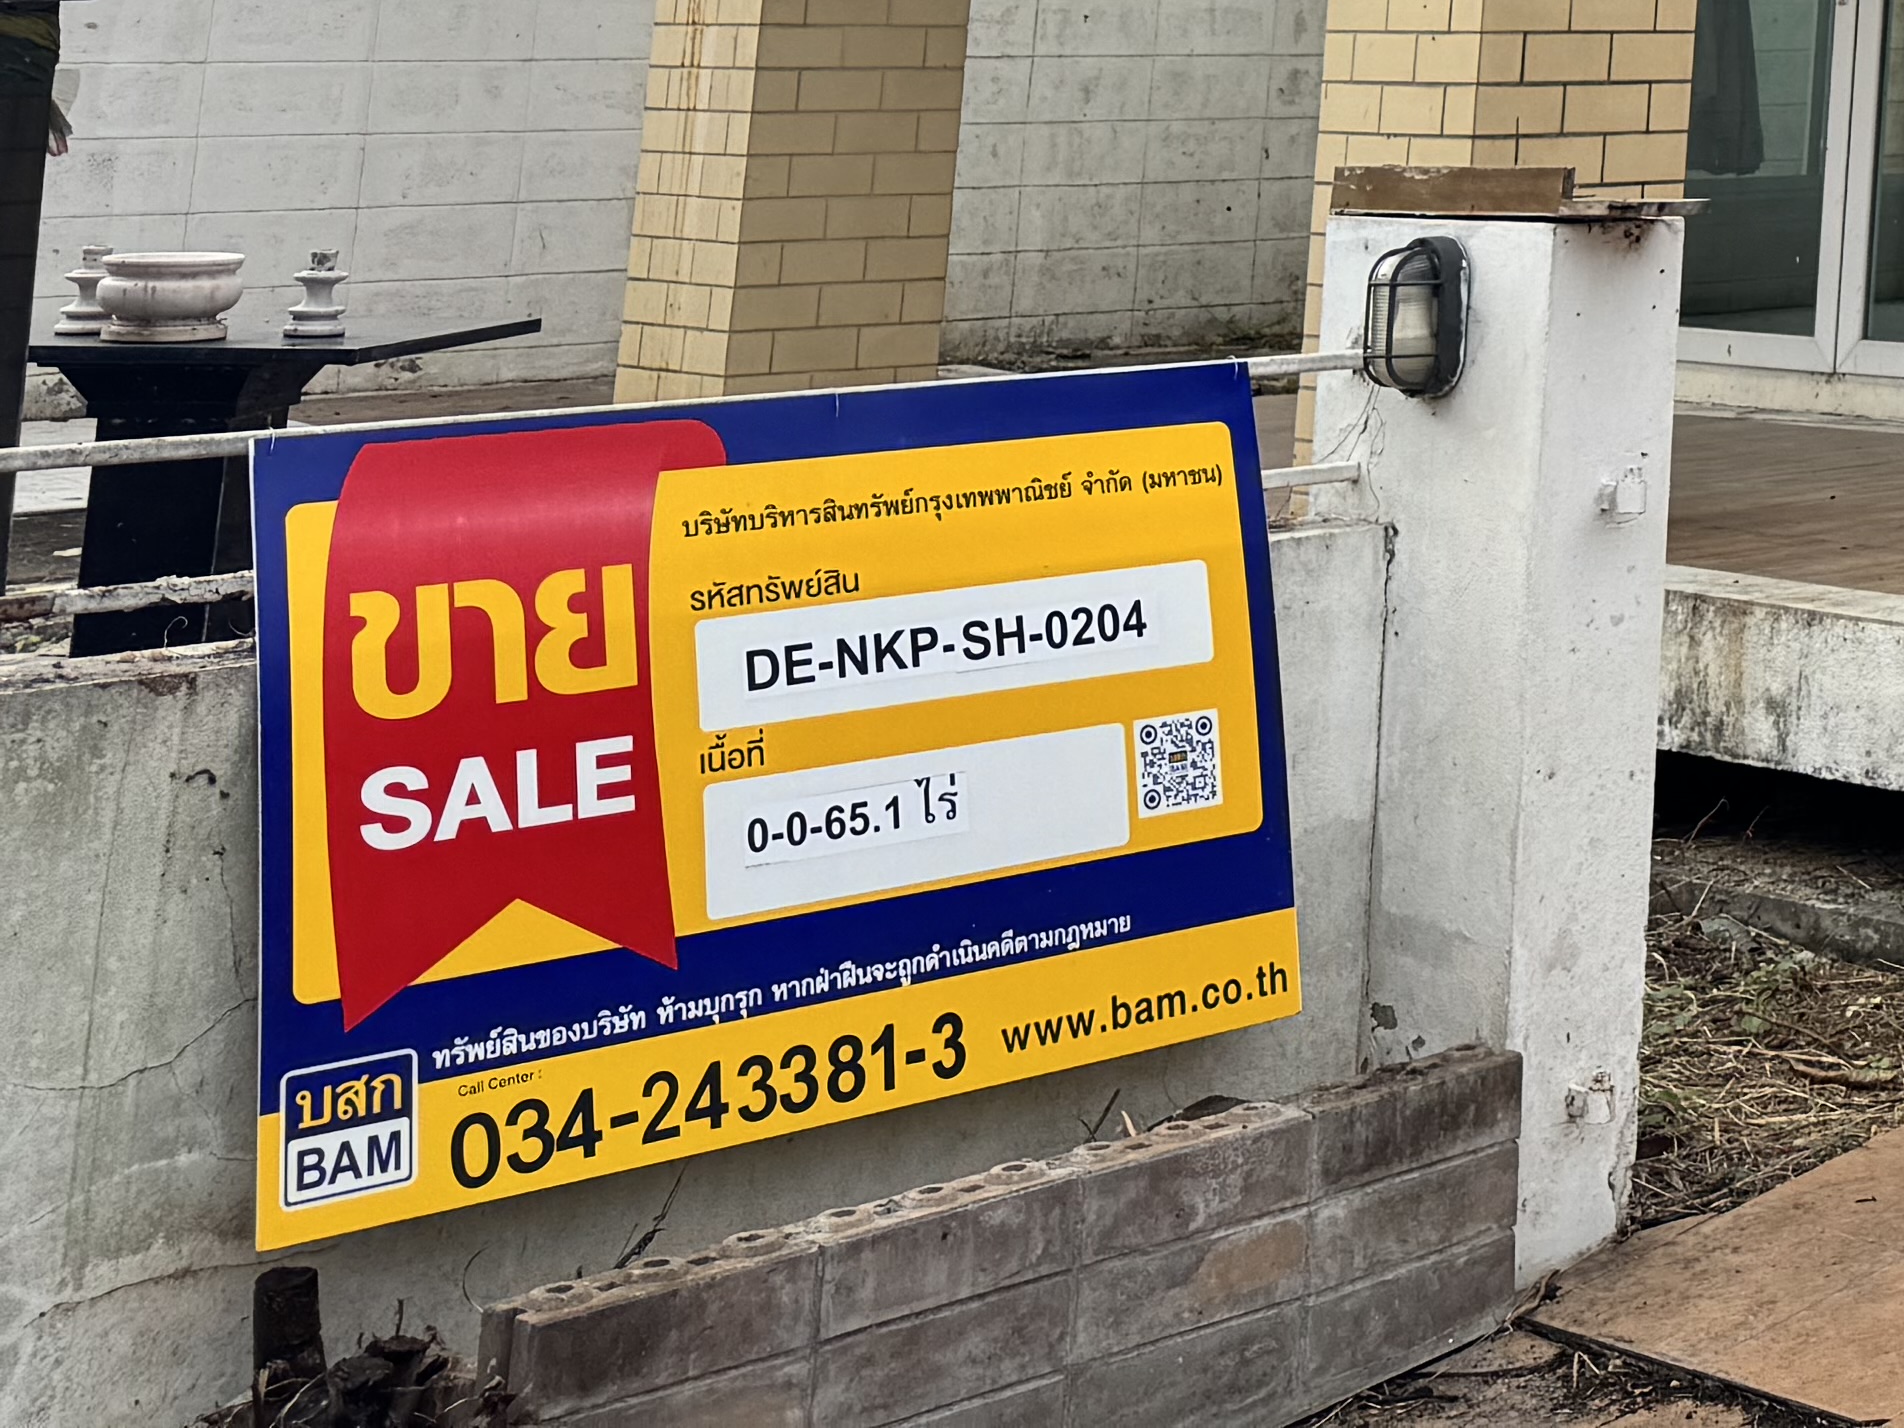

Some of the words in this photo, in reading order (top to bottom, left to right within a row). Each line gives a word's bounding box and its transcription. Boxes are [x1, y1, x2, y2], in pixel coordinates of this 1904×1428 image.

[682, 471, 1072, 538] บริษัทบริหารสินทรัพย์กรุงเทพพาณิชย์
[1081, 469, 1133, 497] จำกัด
[1142, 463, 1223, 494] (มหาชน)
[689, 568, 860, 612] รหัสทรัพย์สิน
[349, 563, 639, 720] ขาย
[745, 599, 1148, 693] DE-NKP-SH-0204
[698, 728, 766, 775] เนื้อที่
[359, 734, 636, 851] SALE
[746, 793, 903, 855] 0-0-65.1
[915, 775, 960, 826] ไร่
[432, 1004, 646, 1070] ทรัพย์สินของบริษัท
[656, 985, 762, 1025] ห้ามบุกรุก
[771, 914, 1132, 1003] หากฝ่าฝืนจะถูกดำเนินคดีตามกฎหมาย
[295, 1072, 402, 1130] บสก
[450, 1011, 967, 1190] 034-243381-3
[1000, 960, 1290, 1057] www.bam.co.th
[458, 1080, 485, 1097] Call
[296, 1130, 401, 1192] BAM
